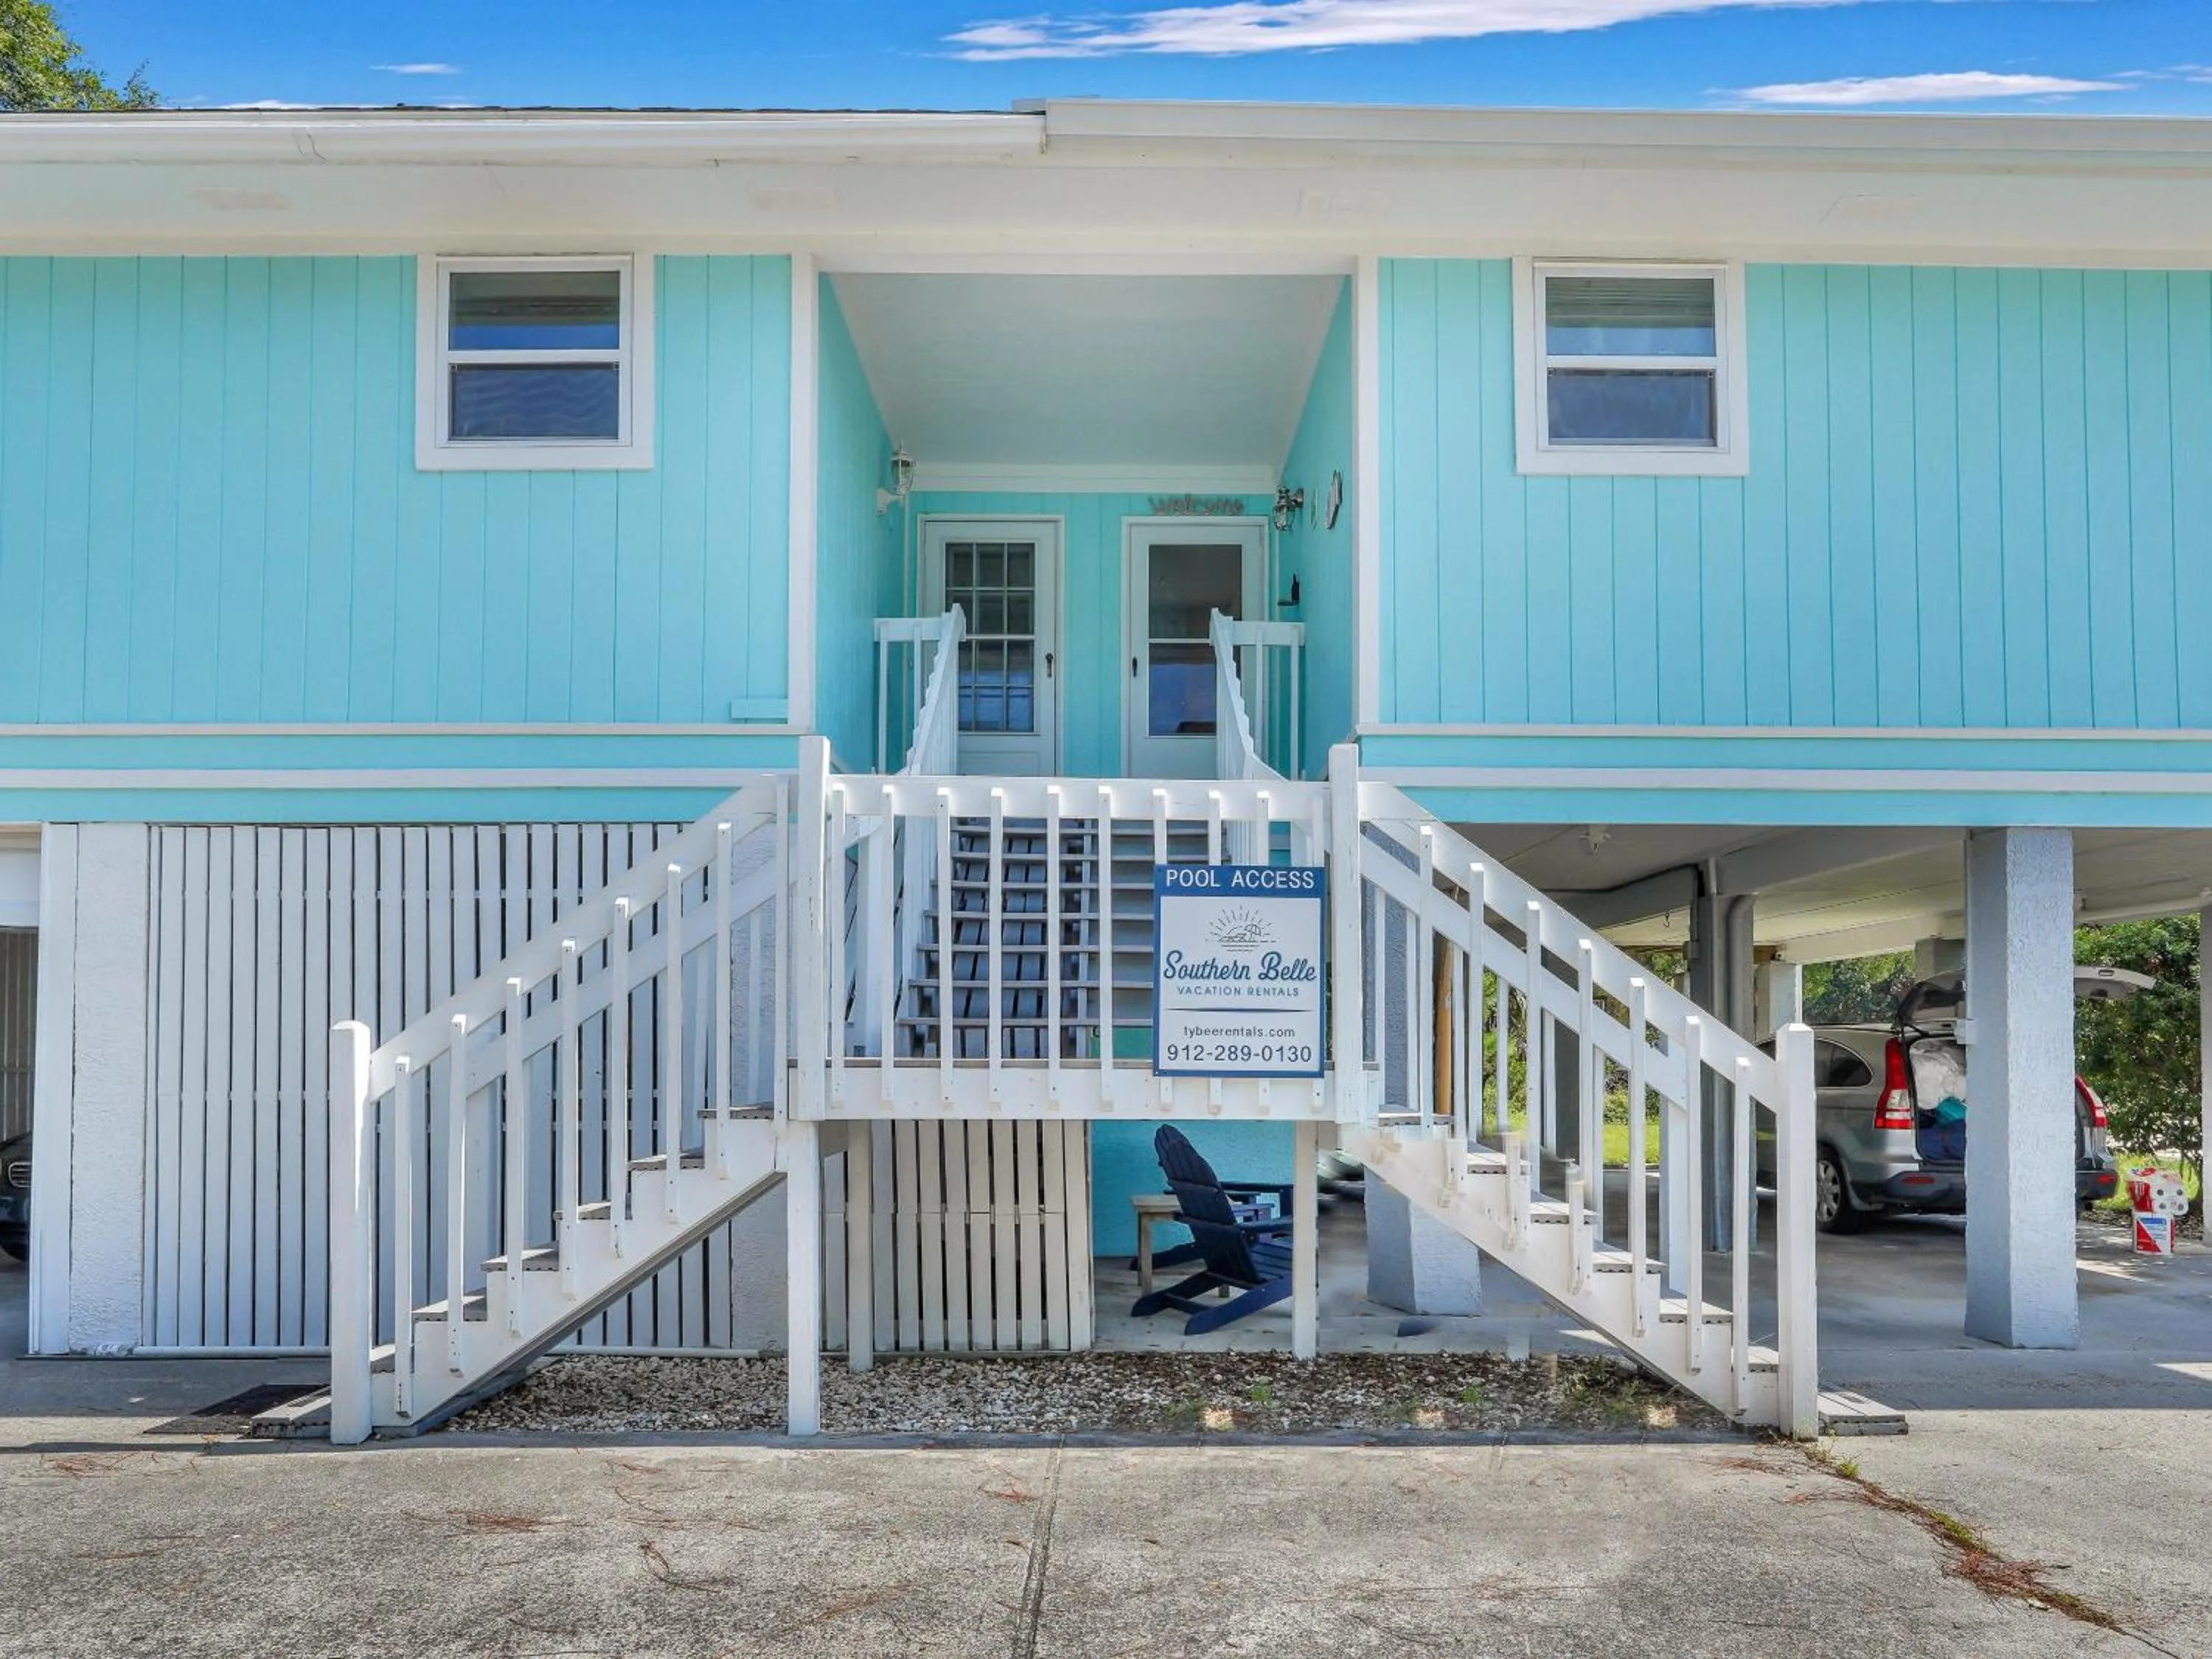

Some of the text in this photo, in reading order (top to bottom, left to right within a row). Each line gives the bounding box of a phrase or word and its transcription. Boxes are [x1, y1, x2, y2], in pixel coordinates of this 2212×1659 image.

[1166, 869, 1315, 888] POOL ACCESS
[1163, 950, 1317, 981] Southern Belle
[1178, 986, 1299, 997] VACATION RENTALS
[1183, 1026, 1295, 1039] tybeerentals.com
[1166, 1044, 1312, 1062] 912-289-0130
